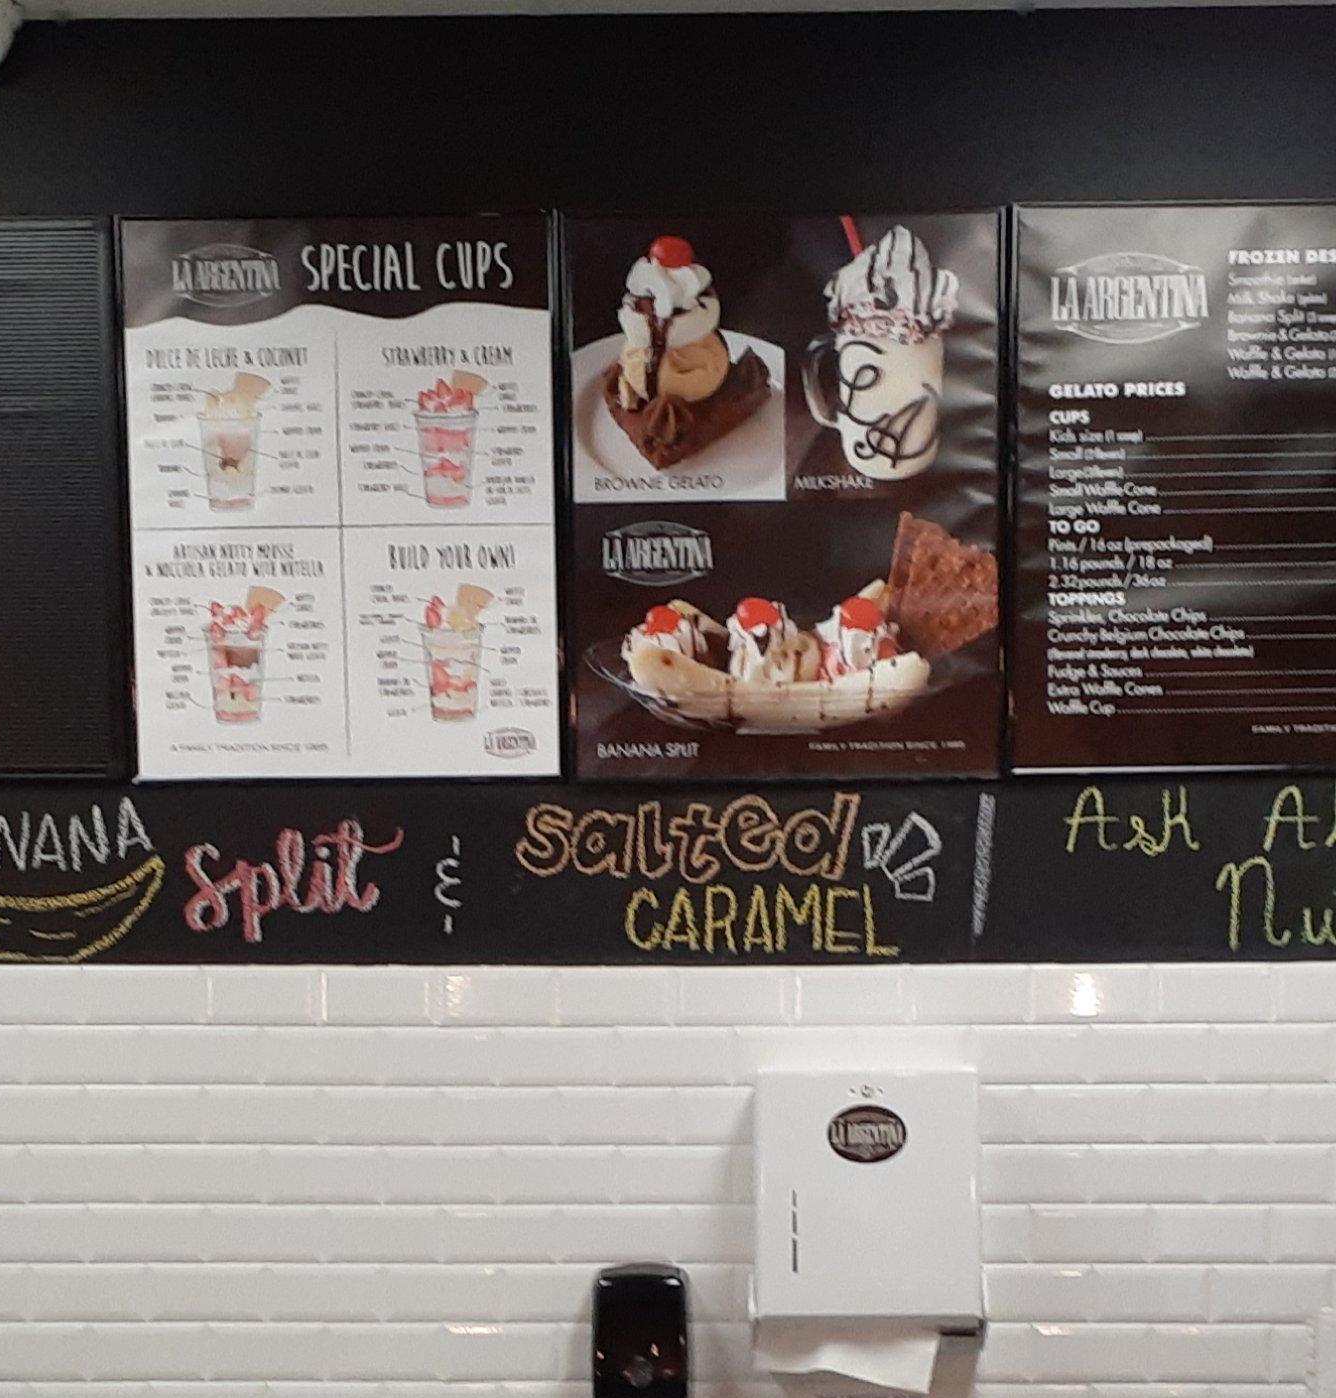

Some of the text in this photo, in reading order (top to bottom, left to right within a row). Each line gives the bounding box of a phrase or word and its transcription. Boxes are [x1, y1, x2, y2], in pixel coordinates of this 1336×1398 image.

[1228, 248, 1300, 264] FROZEN
[300, 241, 514, 292] SPECIAL CUPS
[1051, 274, 1209, 322] LA ARGENTINA
[1048, 381, 1186, 399] GELATO PRICES
[1049, 409, 1091, 425] CUPS
[594, 474, 724, 493] BROWNIE GELATO
[792, 473, 875, 492] MILKSHAKE
[1047, 519, 1101, 535] TO GO
[388, 543, 431, 570] BUILD
[437, 543, 472, 569] YOUR
[1047, 591, 1127, 606] TOPPINGS
[596, 741, 700, 760] BANANA SPLIT
[182, 818, 406, 944] Split
[624, 882, 901, 957] CARAMEL
